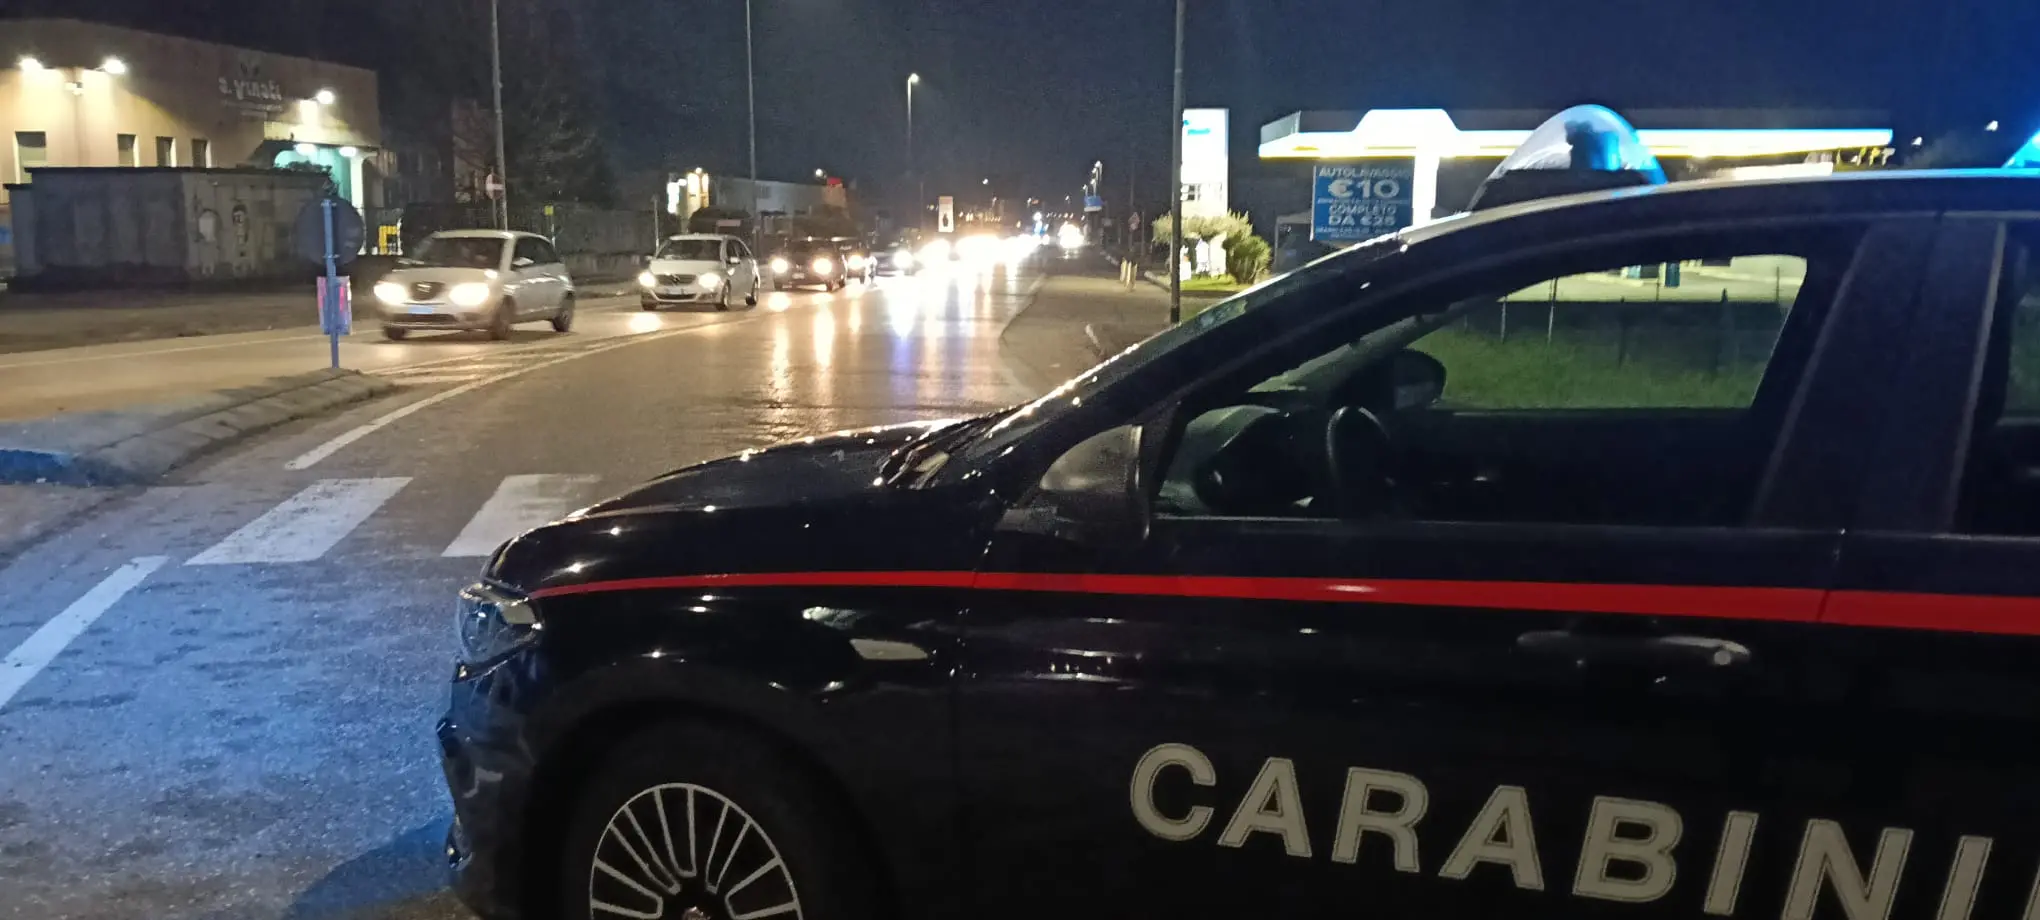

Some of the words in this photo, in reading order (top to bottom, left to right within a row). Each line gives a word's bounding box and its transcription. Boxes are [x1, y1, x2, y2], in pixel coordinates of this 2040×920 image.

[1327, 179, 1400, 199] €10
[1328, 204, 1397, 215] COMPLETO
[1328, 215, 1356, 226] DA
[1130, 742, 2040, 920] CARABINI
